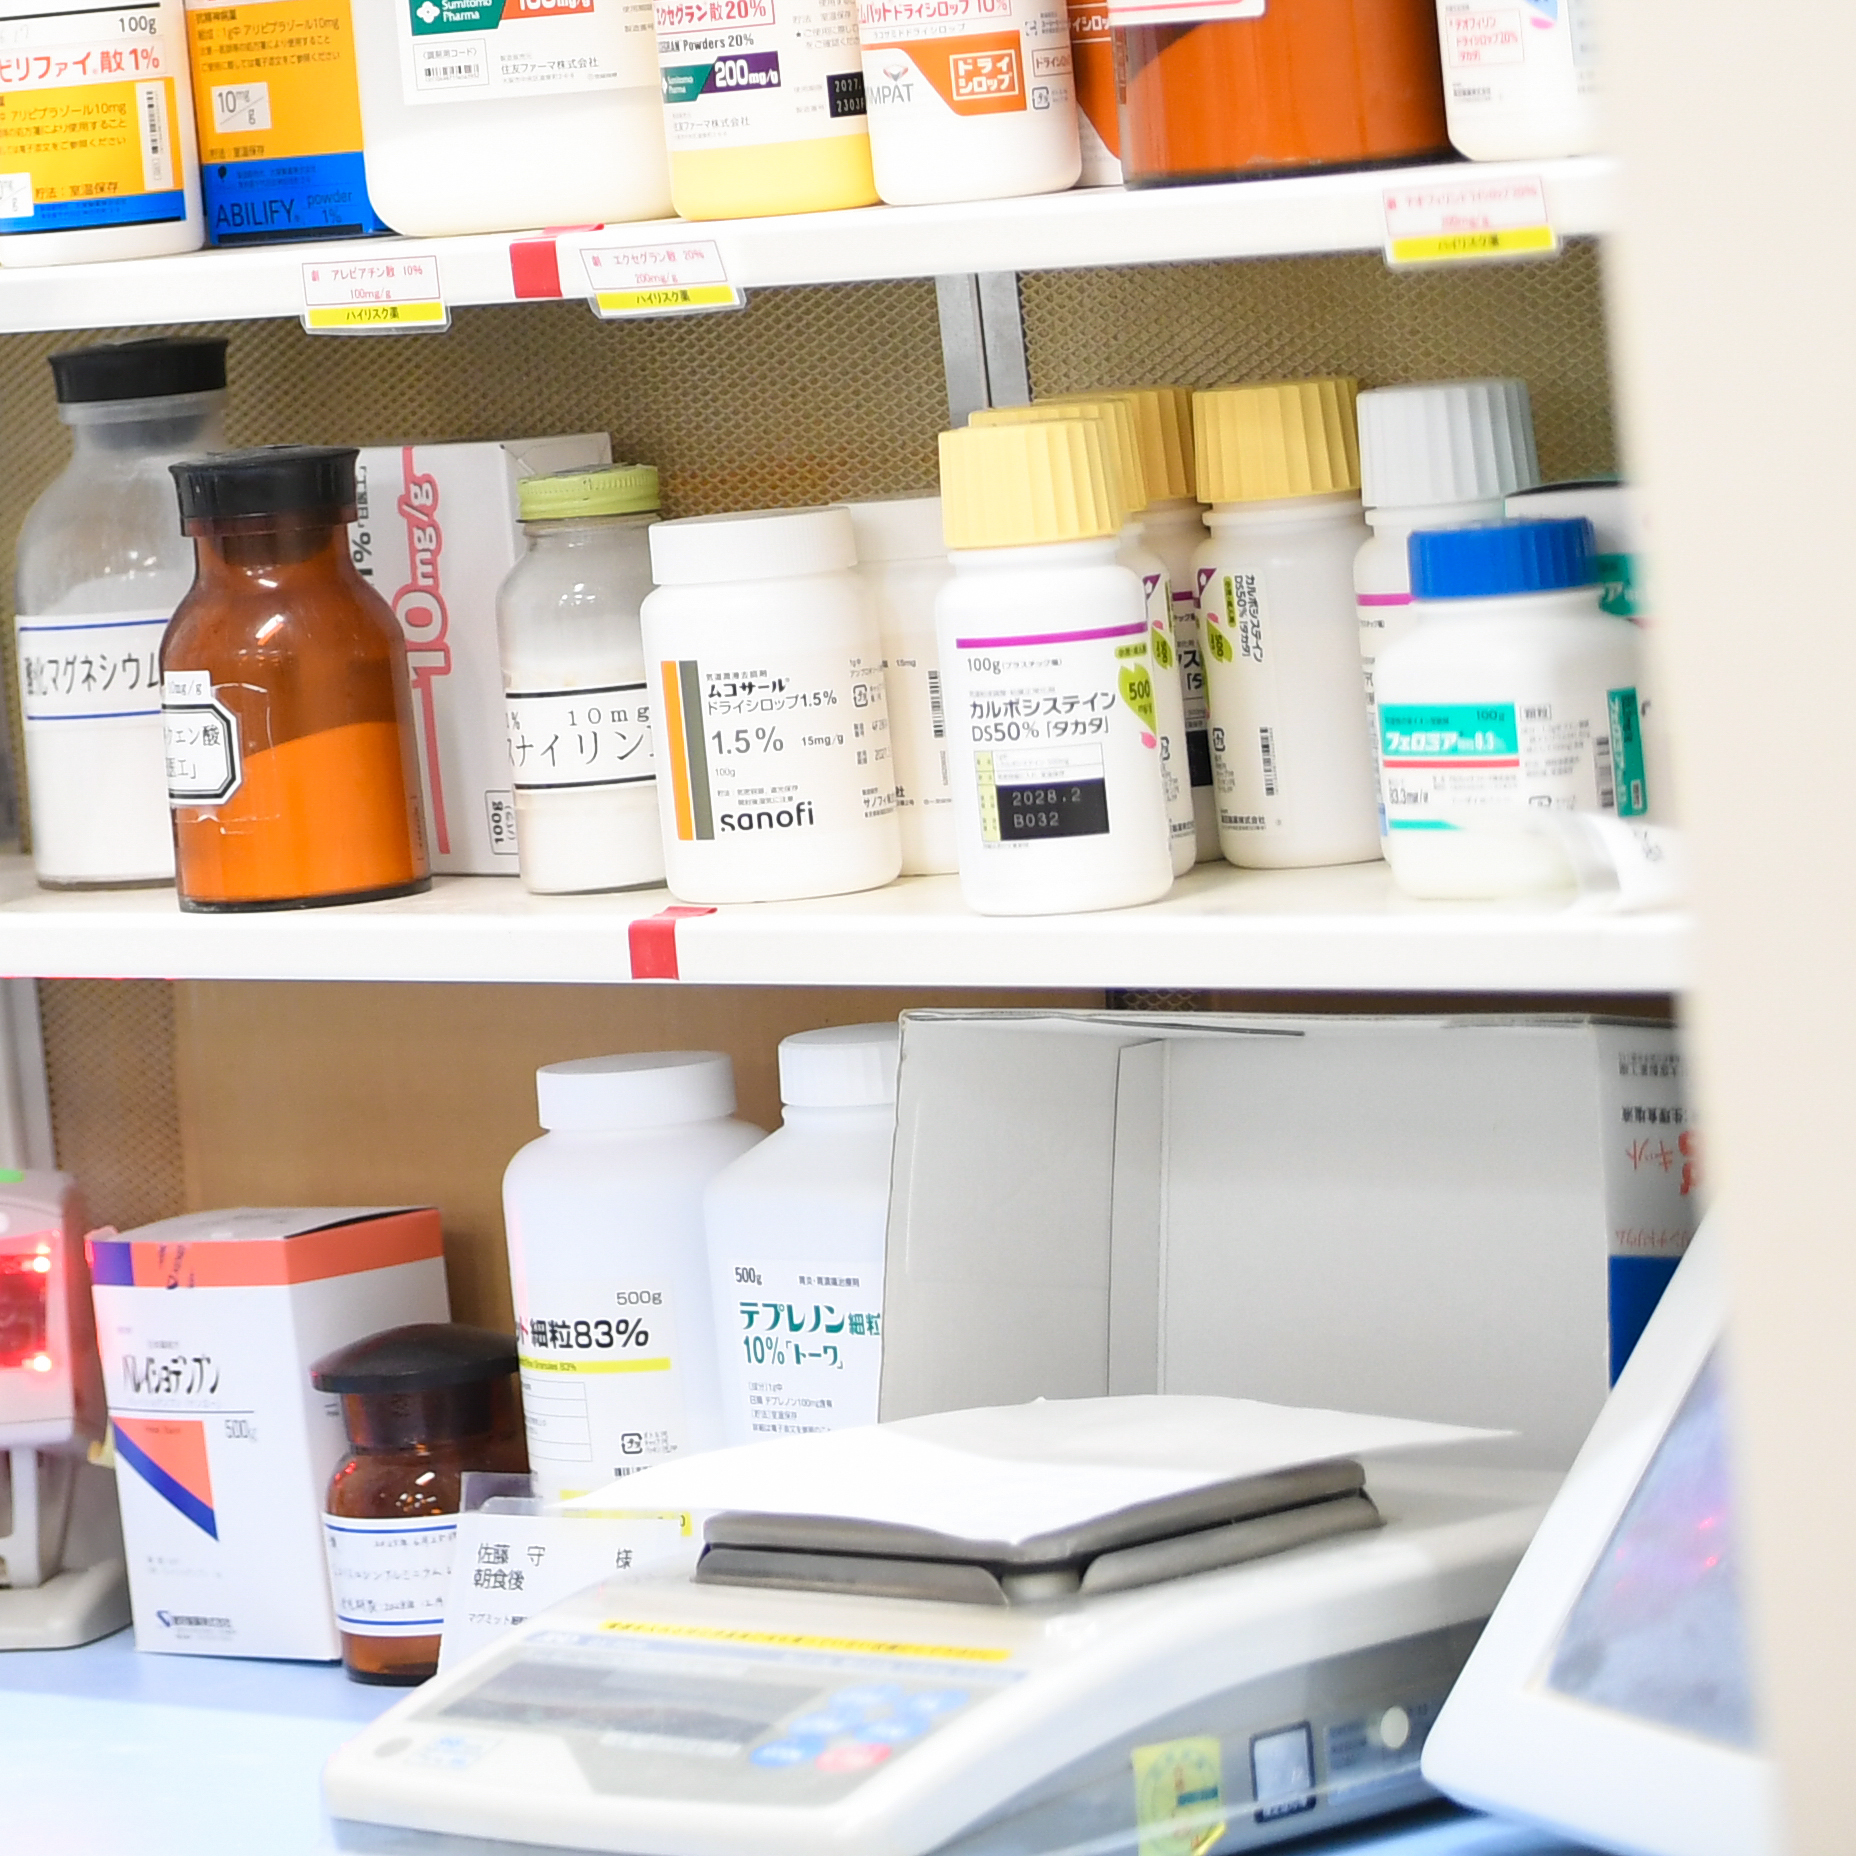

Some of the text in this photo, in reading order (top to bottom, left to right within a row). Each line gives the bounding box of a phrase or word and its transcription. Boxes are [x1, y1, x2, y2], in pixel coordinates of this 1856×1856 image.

[117, 16, 157, 36] 100g
[442, 8, 481, 24] Pharma
[684, 32, 755, 53] Powders 20%
[501, 55, 599, 76] 住友ファーマ株式会社
[714, 58, 779, 88] 200mg/g
[957, 56, 1012, 74] ドライ
[958, 74, 1014, 94] シロップ
[306, 189, 353, 209] powder
[216, 201, 296, 229] ABILIFY
[322, 206, 343, 225] 1%
[635, 271, 678, 285] 200mg/g
[350, 287, 392, 300] 100mg/g
[636, 289, 691, 305] ハイリスク薬
[346, 306, 400, 321] ハイリスク薬
[1244, 574, 1264, 664] カルボシステイン
[707, 678, 787, 698] ムコサール
[1128, 679, 1151, 700] 500
[707, 691, 837, 716] ドライシロップ1.5%
[969, 692, 1117, 720] カルボシステイン
[711, 726, 844, 755] 1.5% 15mg/g
[715, 767, 736, 778] 100g
[1011, 788, 1082, 806] 2028.2
[491, 800, 504, 844] 100g
[720, 801, 815, 832] sanofi
[1014, 811, 1060, 829] B032
[1625, 1137, 1676, 1174] キット
[735, 1266, 763, 1286] 500g
[616, 1290, 663, 1307] 500g
[739, 1301, 881, 1336] テプレノン細粒
[743, 1335, 844, 1370] 10%「トーワ」
[477, 1543, 632, 1570] 佐藤 守 様
[472, 1569, 526, 1591] 朝食後
